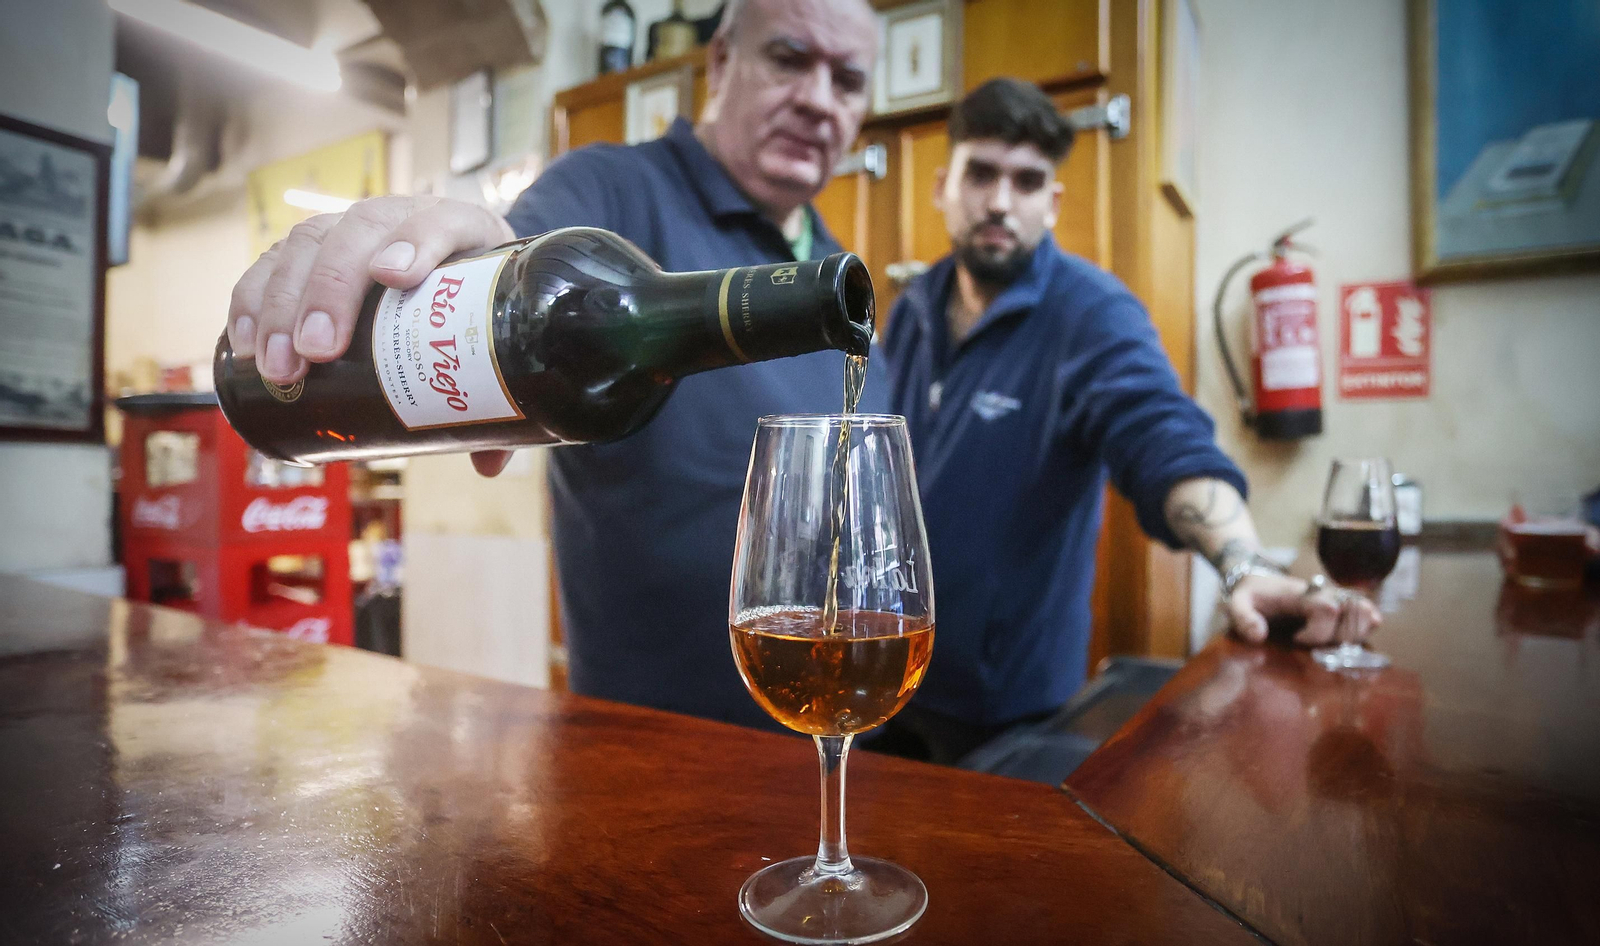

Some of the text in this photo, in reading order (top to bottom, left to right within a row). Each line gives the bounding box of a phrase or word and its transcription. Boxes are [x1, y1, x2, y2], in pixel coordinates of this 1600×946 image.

[405, 328, 413, 362] SECO-DRY
[412, 308, 427, 382] OLOROSO
[429, 274, 469, 411] Río Viejo
